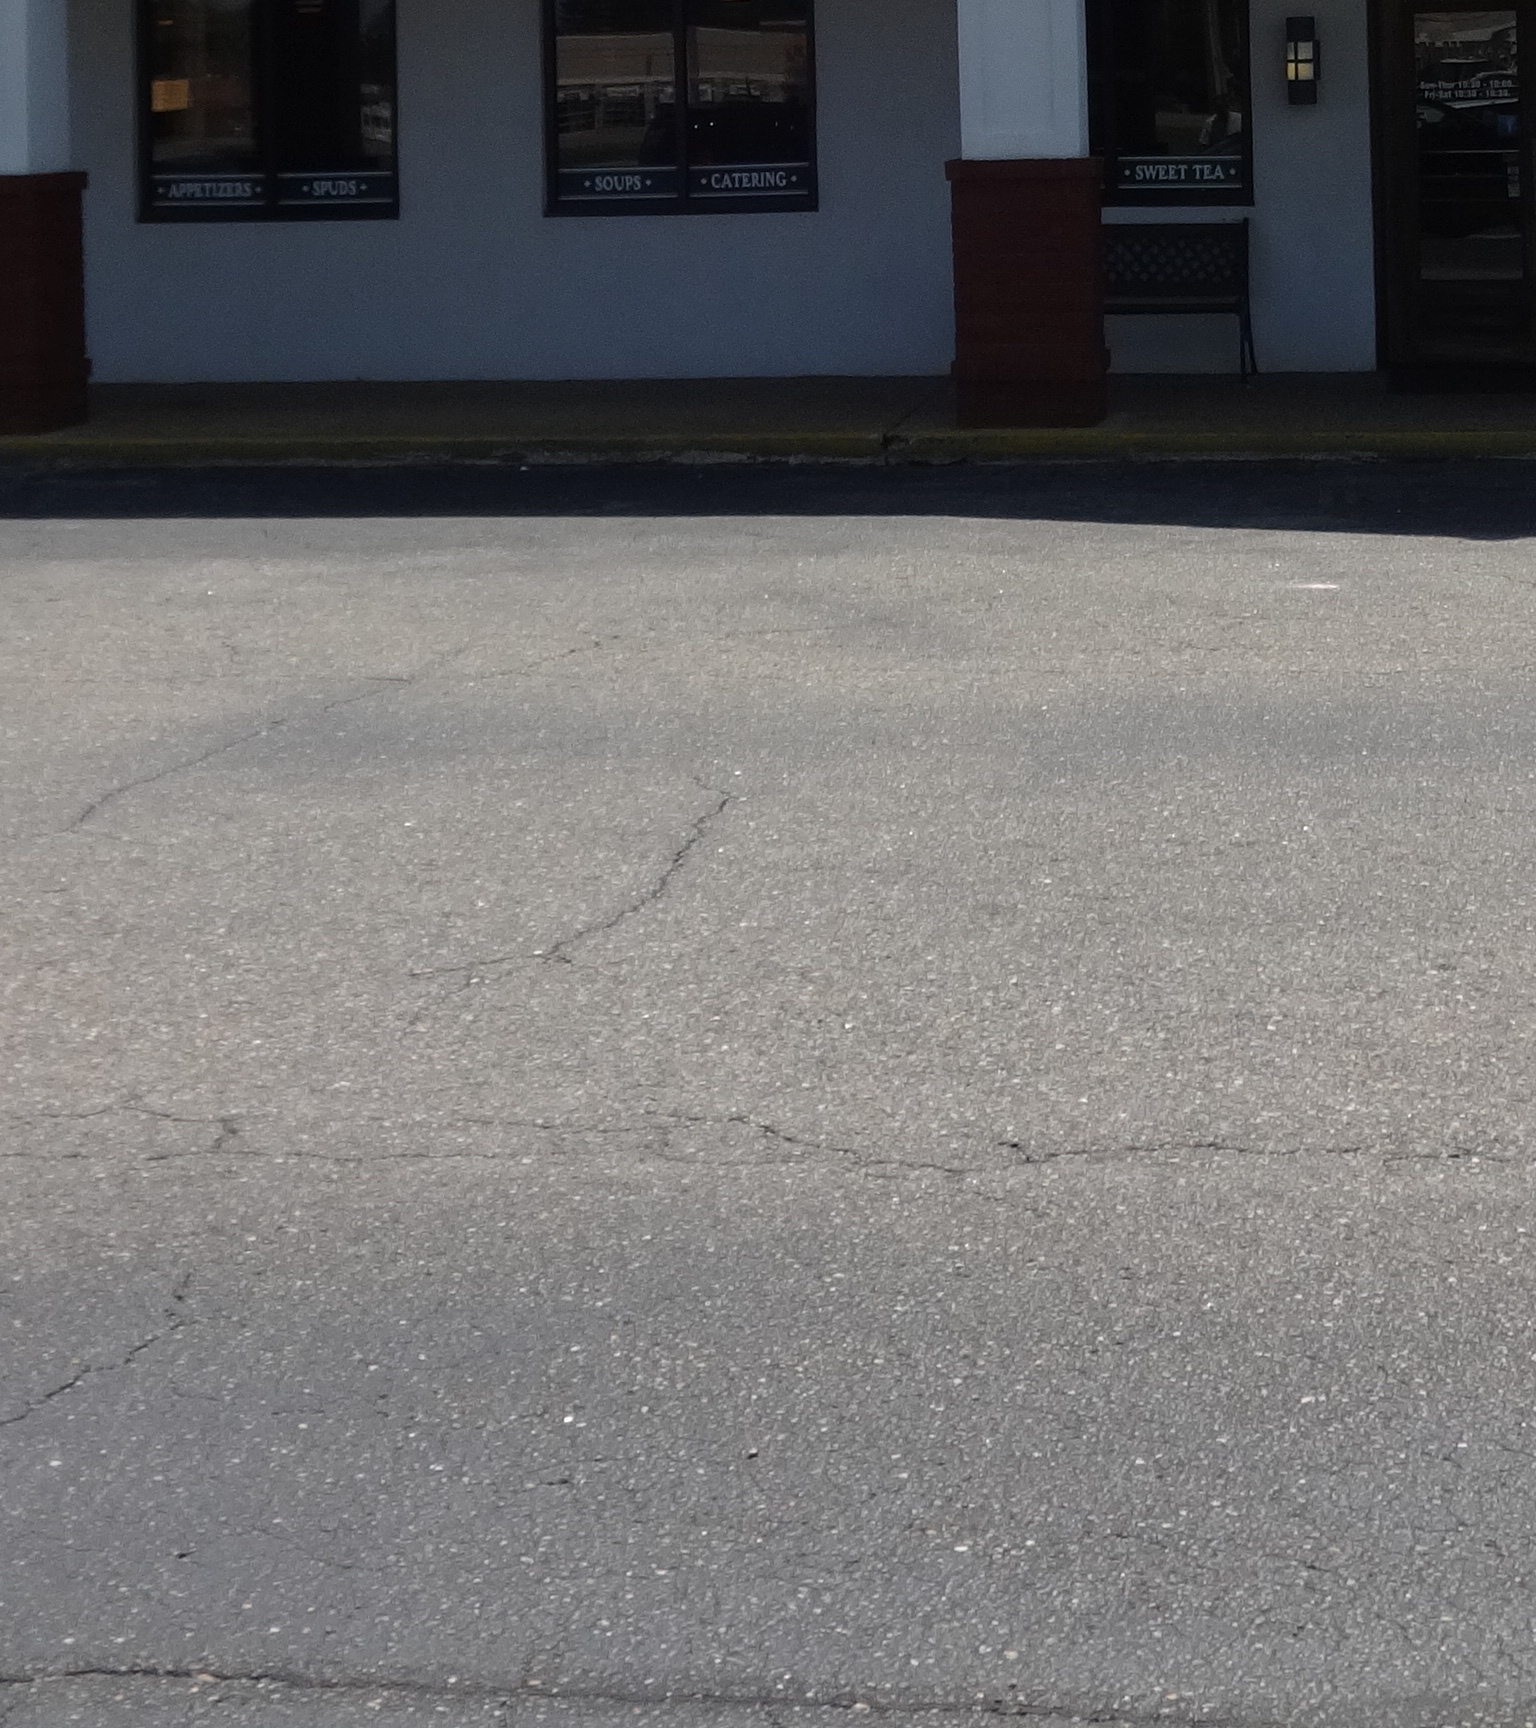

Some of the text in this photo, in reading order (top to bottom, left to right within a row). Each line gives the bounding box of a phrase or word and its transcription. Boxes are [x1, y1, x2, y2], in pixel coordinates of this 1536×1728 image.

[710, 170, 788, 190] CATERING
[1135, 164, 1226, 181] SWEET TEA
[168, 181, 252, 199] APPETIZERS
[311, 179, 358, 197] SPUDS
[594, 174, 642, 193] SOUPS
